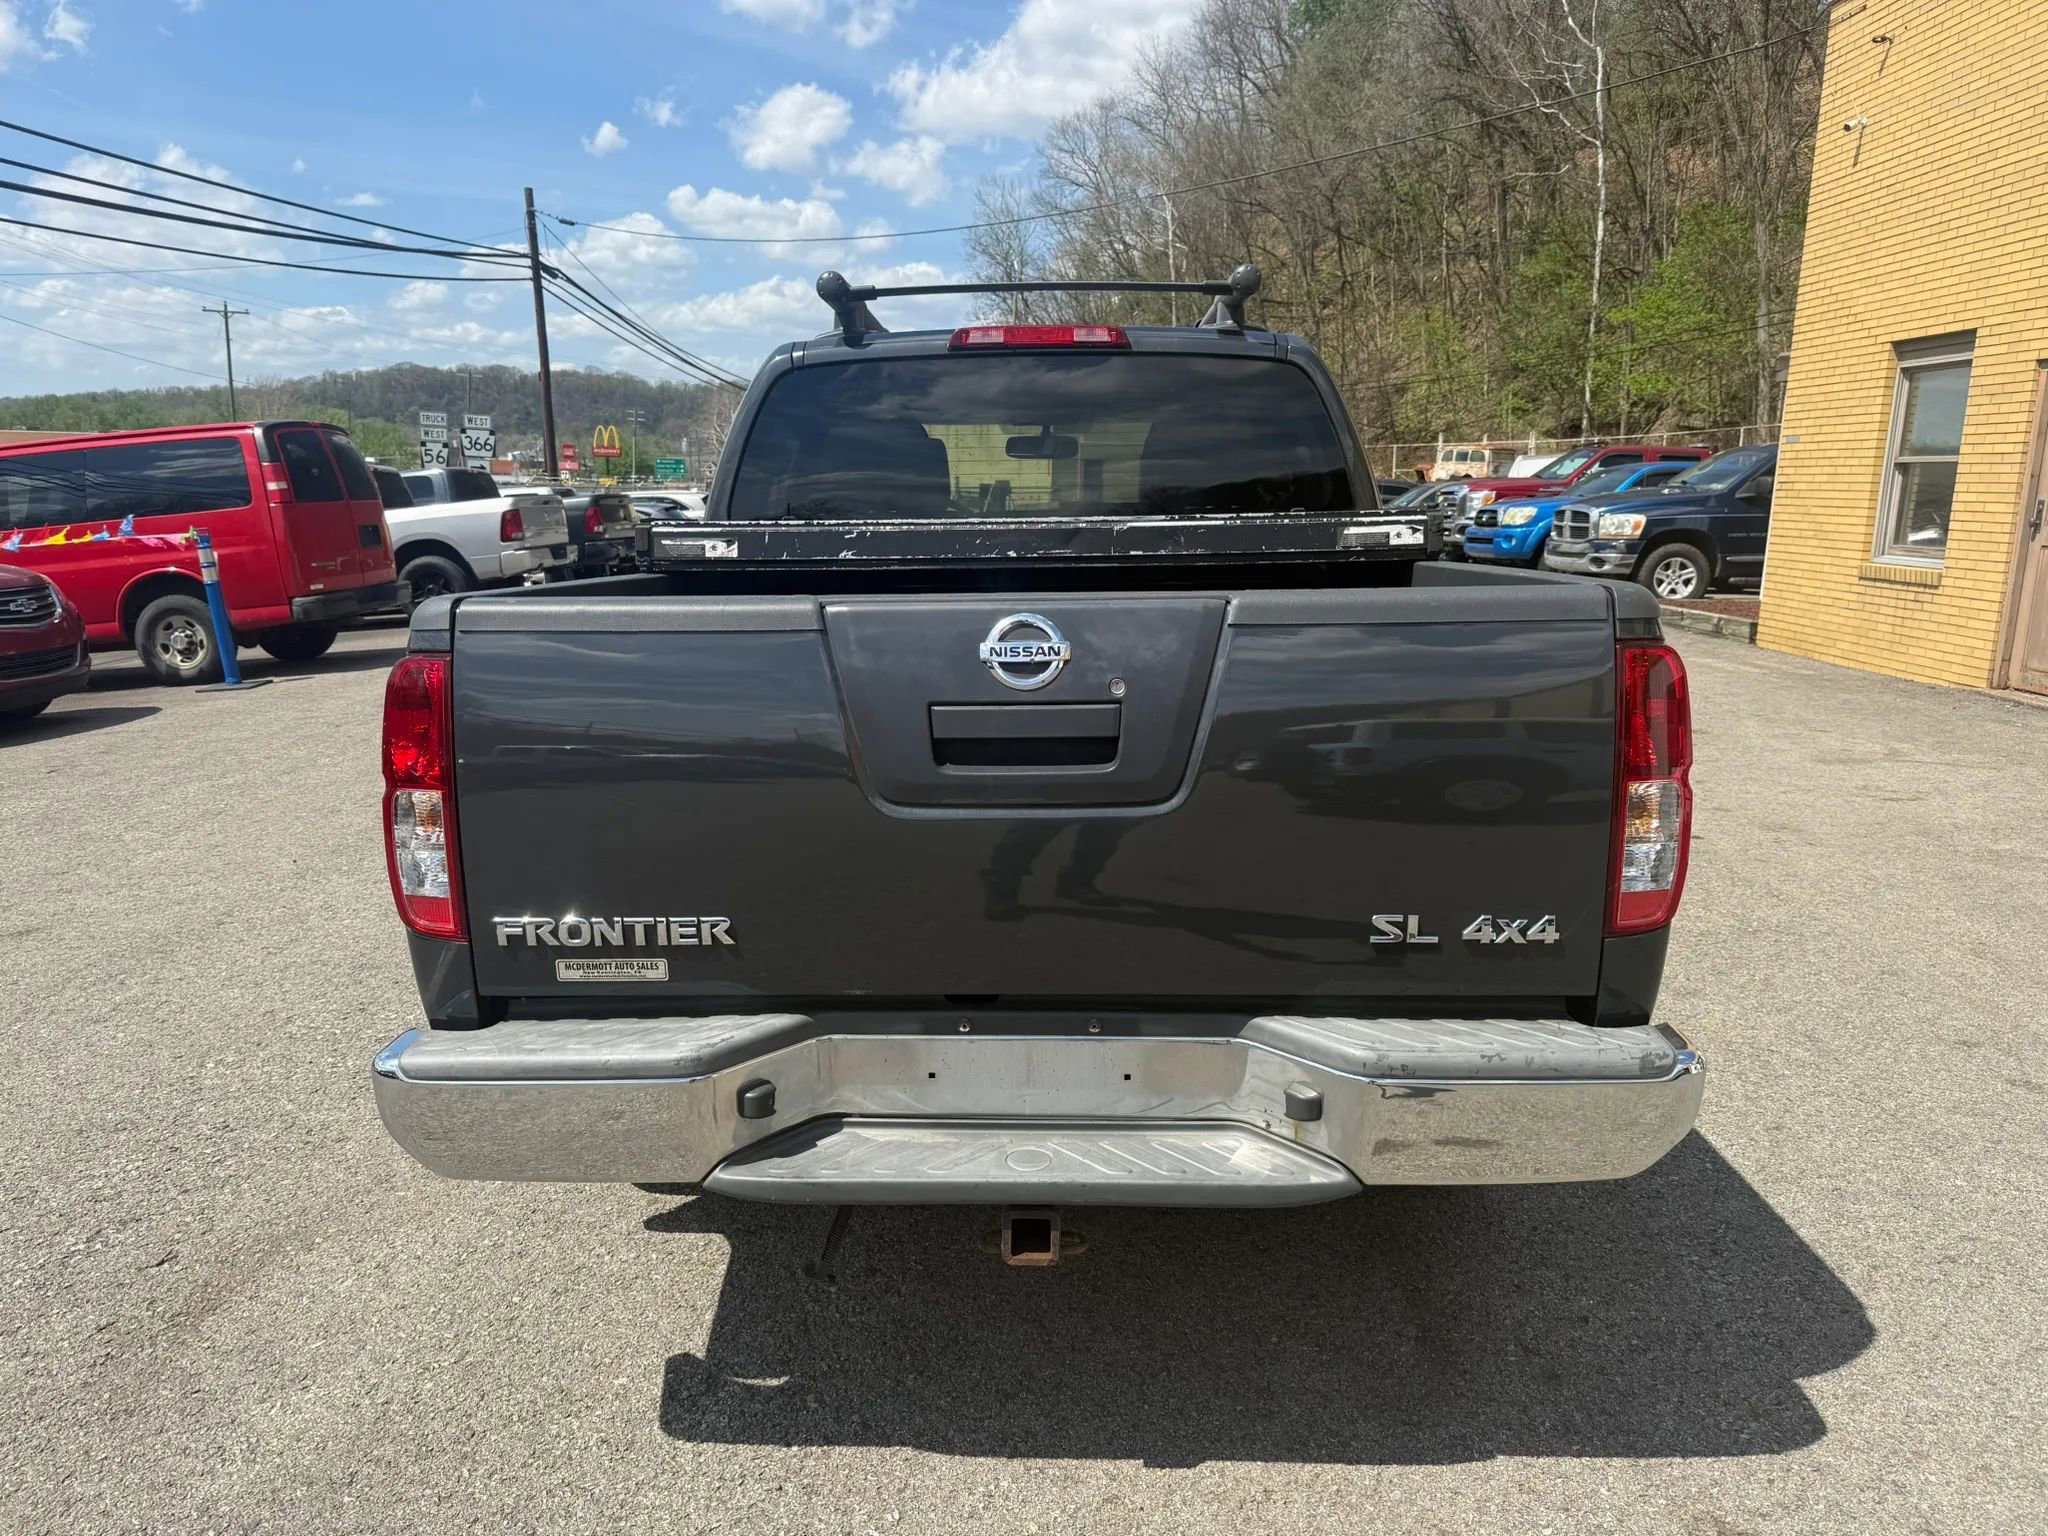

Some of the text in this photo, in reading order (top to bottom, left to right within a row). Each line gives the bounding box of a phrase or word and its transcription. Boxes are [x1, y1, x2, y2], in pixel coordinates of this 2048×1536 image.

[421, 414, 446, 424] TRUCK
[466, 415, 488, 427] WEST
[423, 429, 445, 439] WEST
[464, 435, 493, 452] 366
[424, 448, 446, 465] 56
[989, 645, 1061, 658] NISSAN
[493, 916, 736, 947] FRONTIER
[1369, 914, 1439, 944] SL
[564, 962, 659, 971] MCDERMOTT AUTO SALES
